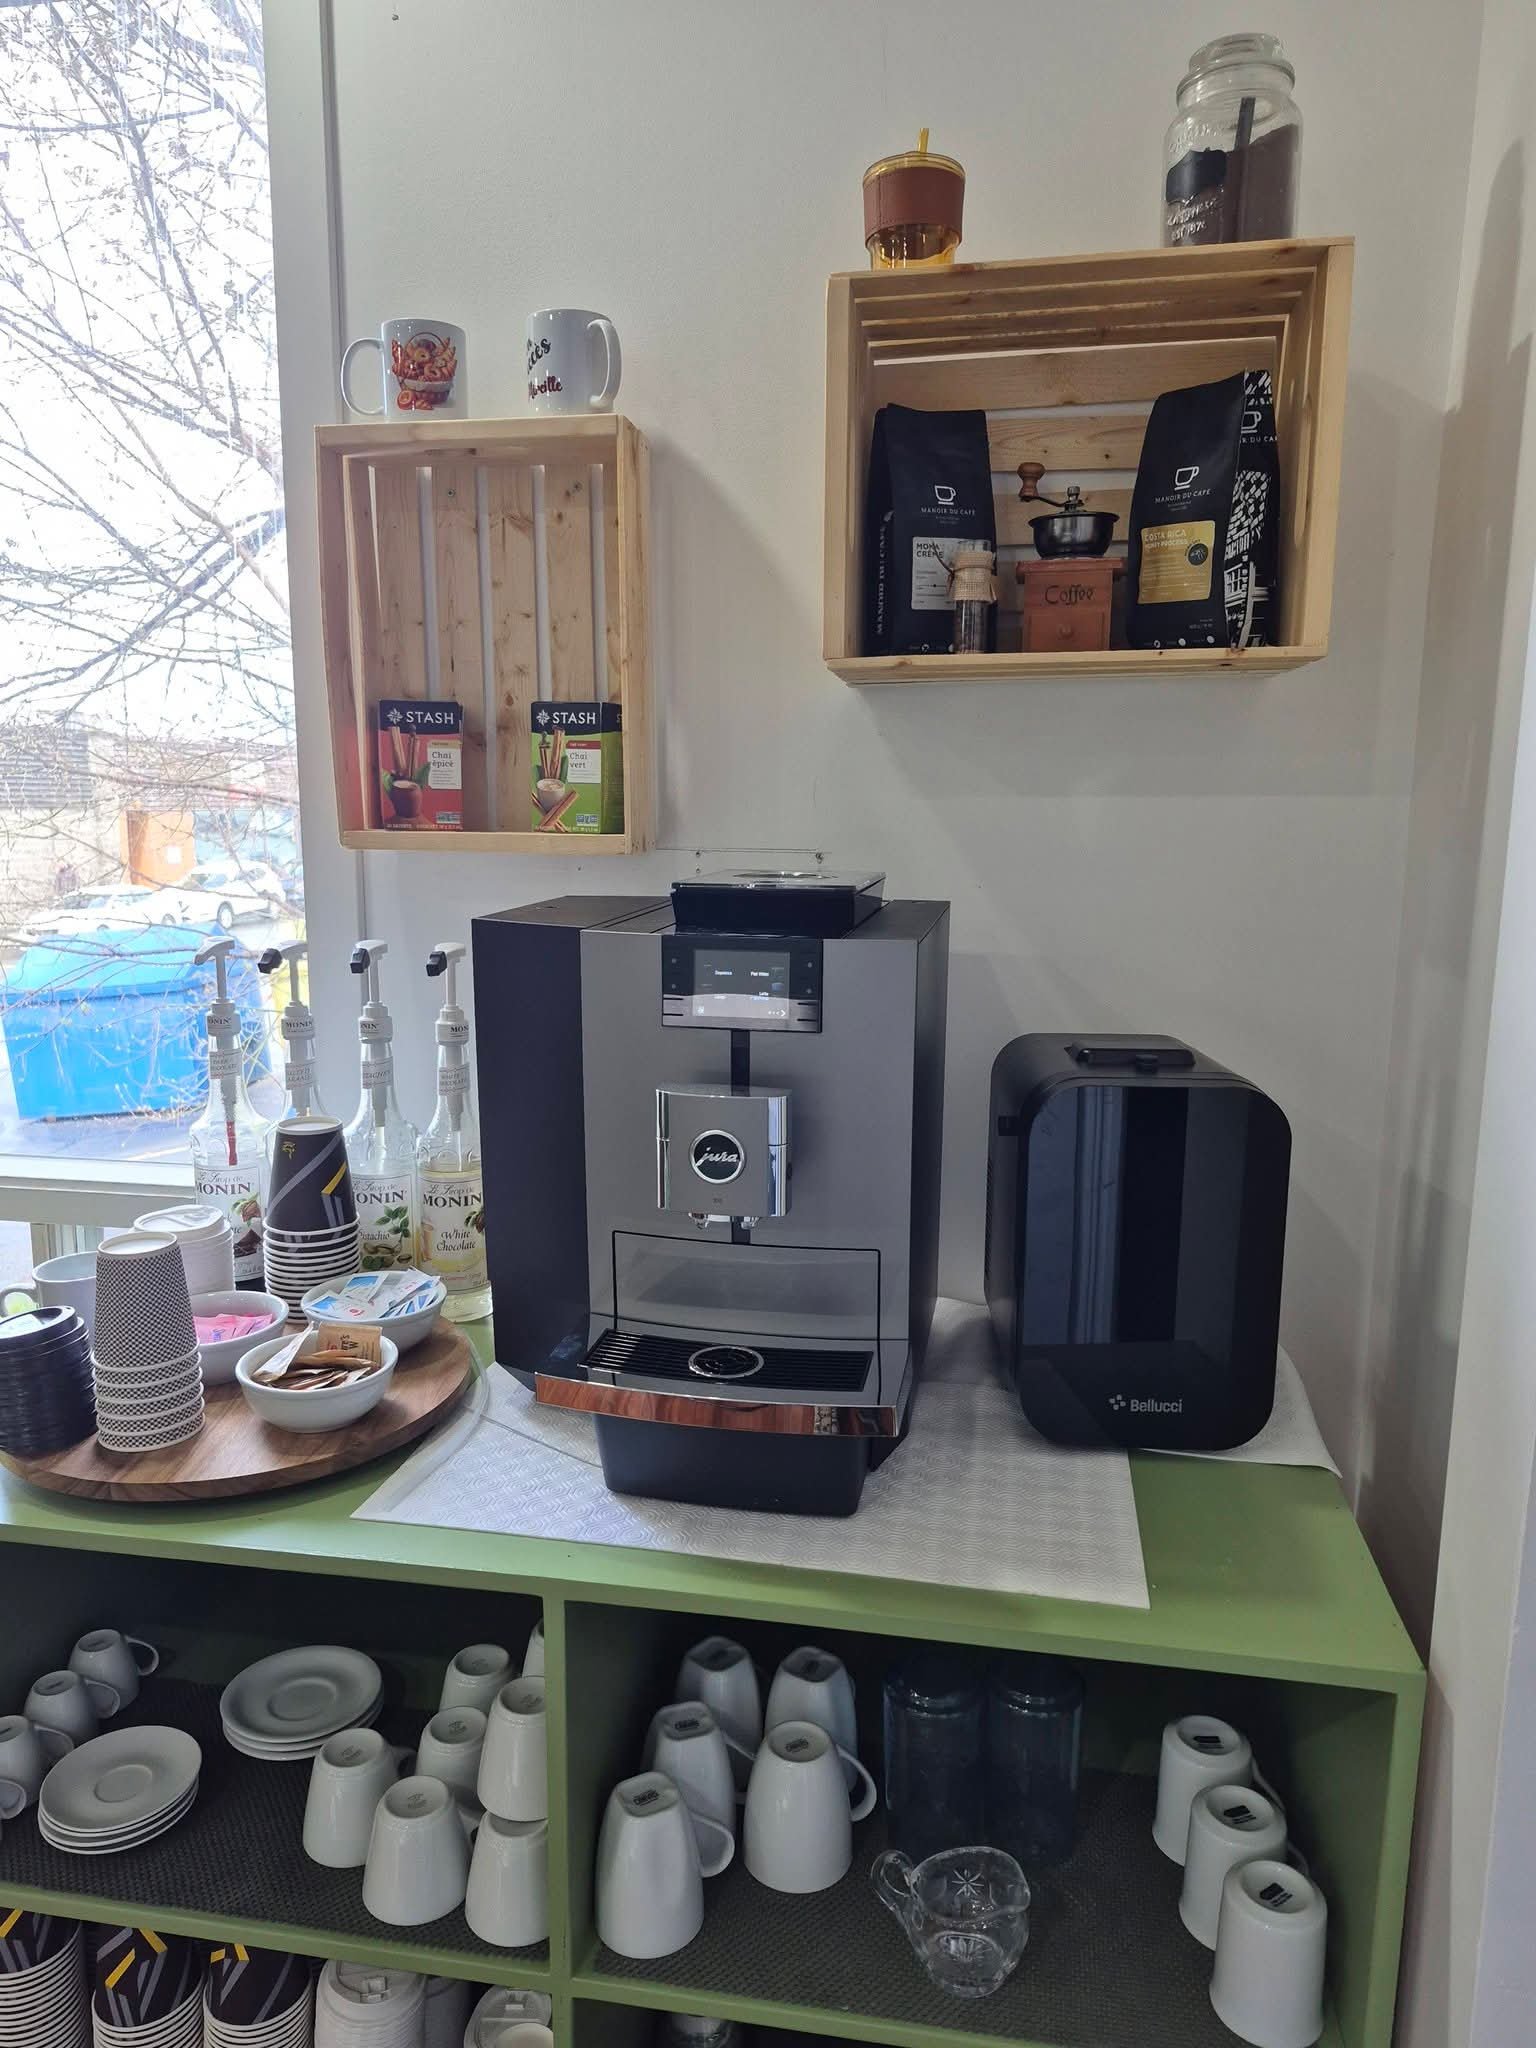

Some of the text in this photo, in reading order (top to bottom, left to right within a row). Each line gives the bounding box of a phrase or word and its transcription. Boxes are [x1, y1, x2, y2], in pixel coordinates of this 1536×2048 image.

[1044, 584, 1096, 606] Coffee
[406, 711, 454, 724] STASH
[551, 711, 597, 725] STASH
[431, 751, 452, 759] Chai
[569, 751, 588, 760] Chai
[207, 1017, 231, 1025] ONIN
[695, 1146, 739, 1168] jura
[355, 1190, 404, 1204] ONIN
[423, 1192, 482, 1207] MONIN
[440, 1227, 471, 1239] White
[436, 1239, 477, 1252] Chocolate
[1130, 1399, 1183, 1413] Bellucci
